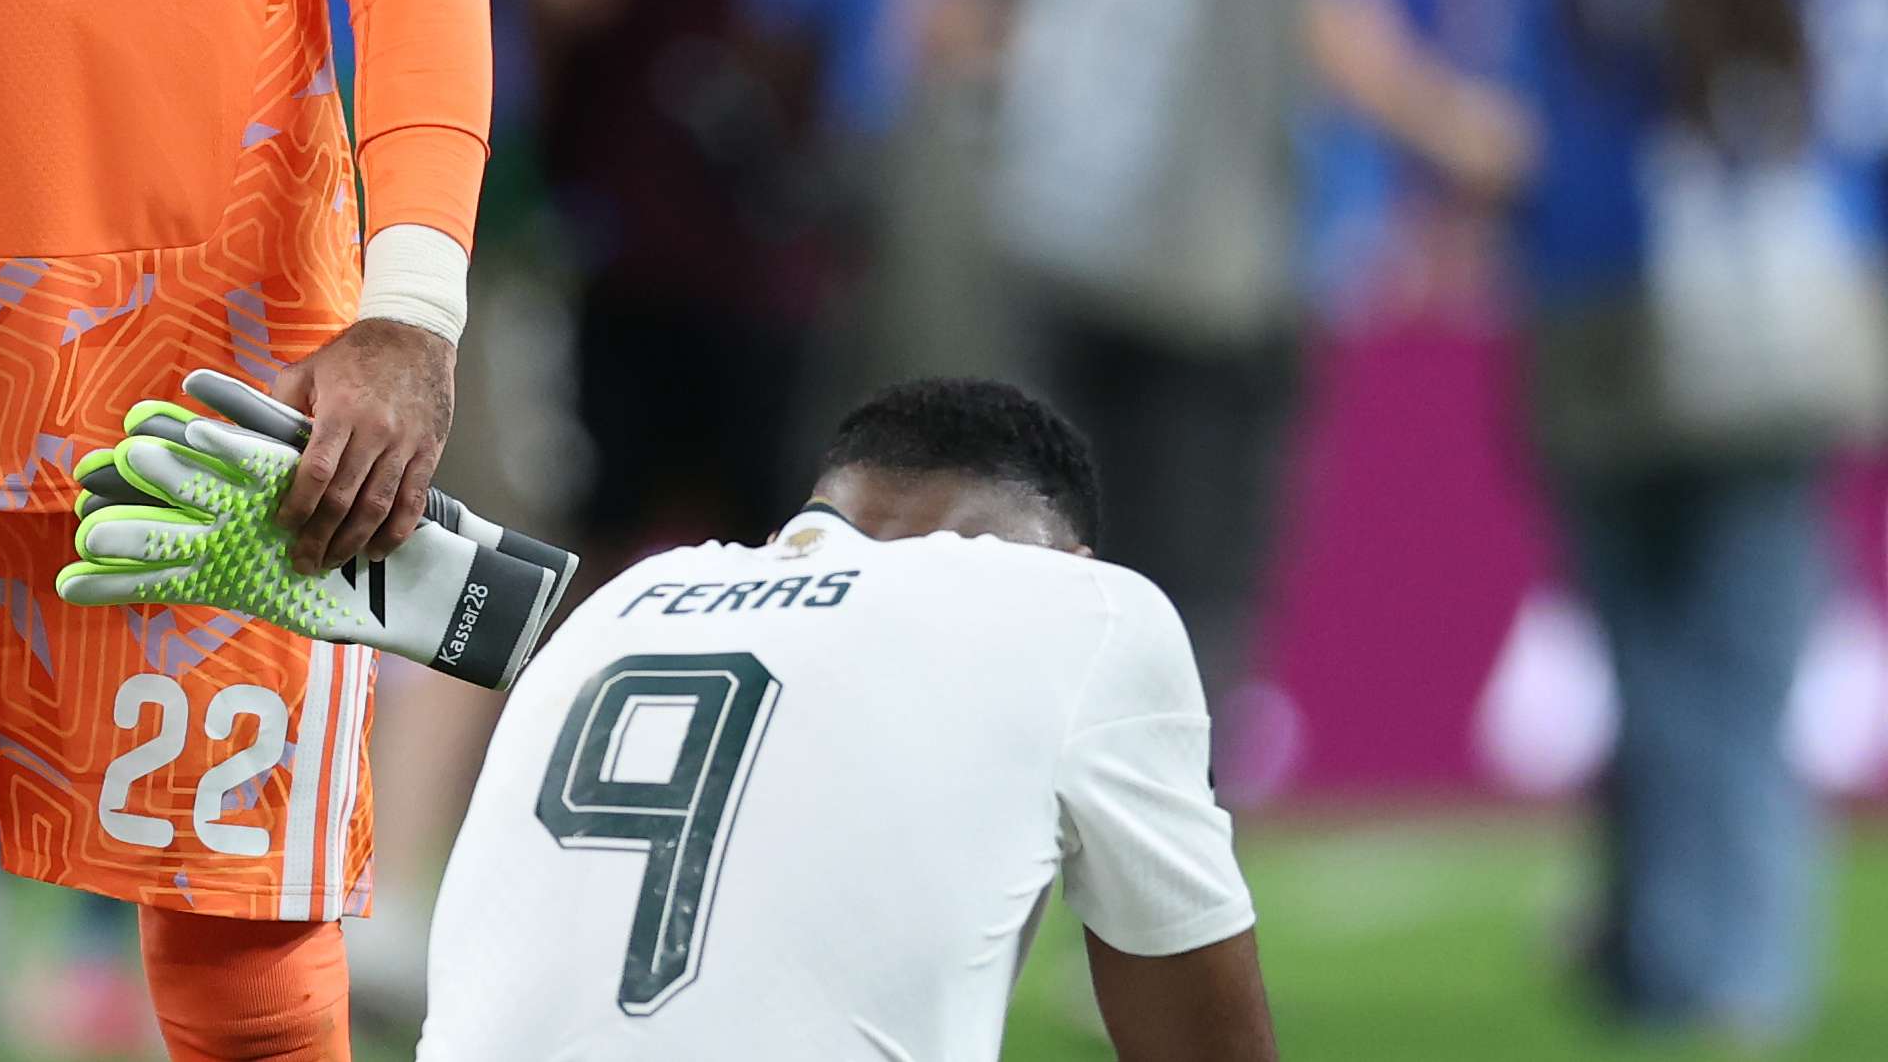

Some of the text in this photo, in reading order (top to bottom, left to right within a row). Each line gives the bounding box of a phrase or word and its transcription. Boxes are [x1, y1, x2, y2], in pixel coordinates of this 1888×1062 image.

[438, 582, 489, 666] Kassar28
[617, 569, 862, 618] FERAS
[98, 673, 289, 857] 22
[535, 652, 783, 1017] 9
